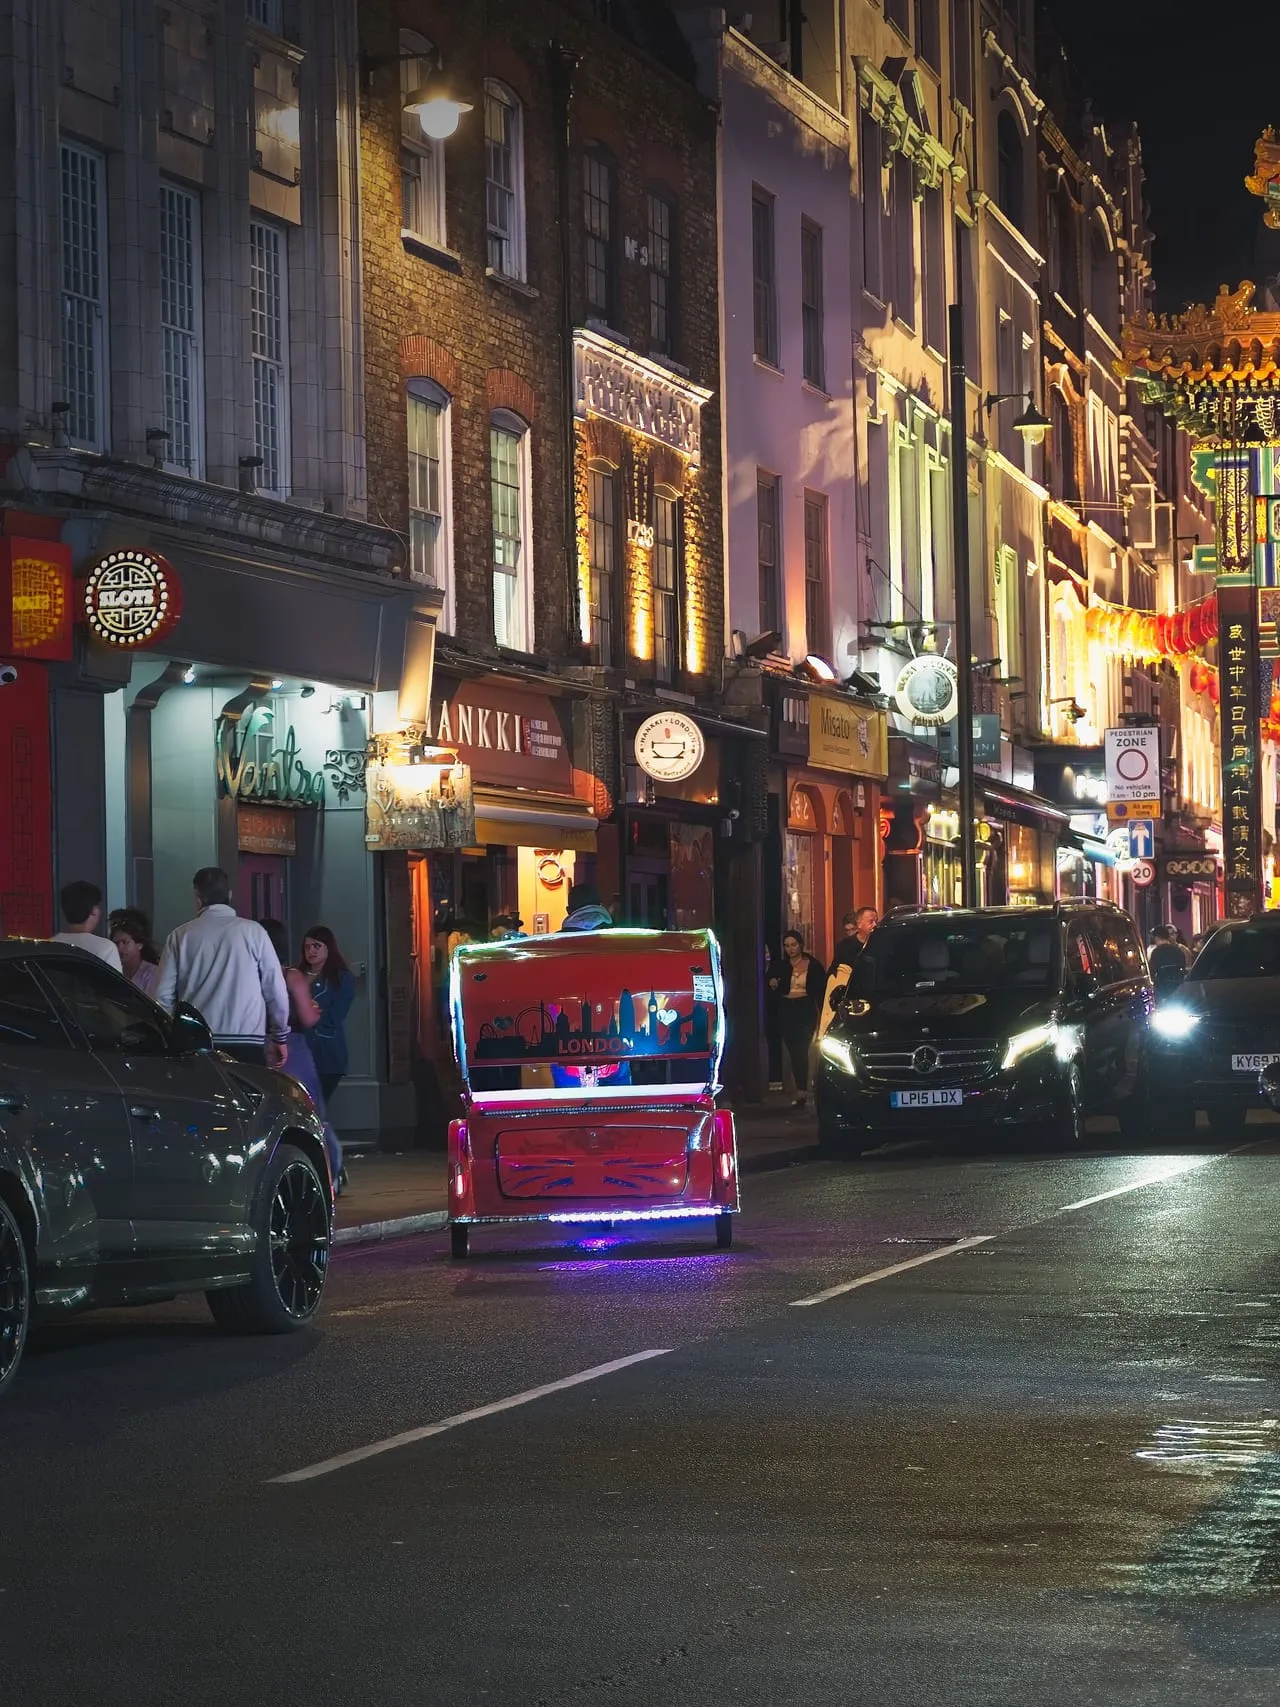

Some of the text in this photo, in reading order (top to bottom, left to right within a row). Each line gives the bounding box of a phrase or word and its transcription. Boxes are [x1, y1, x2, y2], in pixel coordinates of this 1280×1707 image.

[99, 590, 153, 607] SLOTS
[640, 718, 697, 744] HANKKI LONDON
[821, 707, 849, 740] Misato
[1110, 729, 1153, 737] PEDESTRIAN
[1116, 738, 1147, 747] ZONE
[216, 704, 325, 801] Vantra
[1132, 790, 1141, 798] 10
[1143, 791, 1156, 800] pm
[1133, 868, 1151, 879] 20
[558, 1038, 634, 1055] LONDON
[901, 1091, 957, 1105] LP15 LDX
